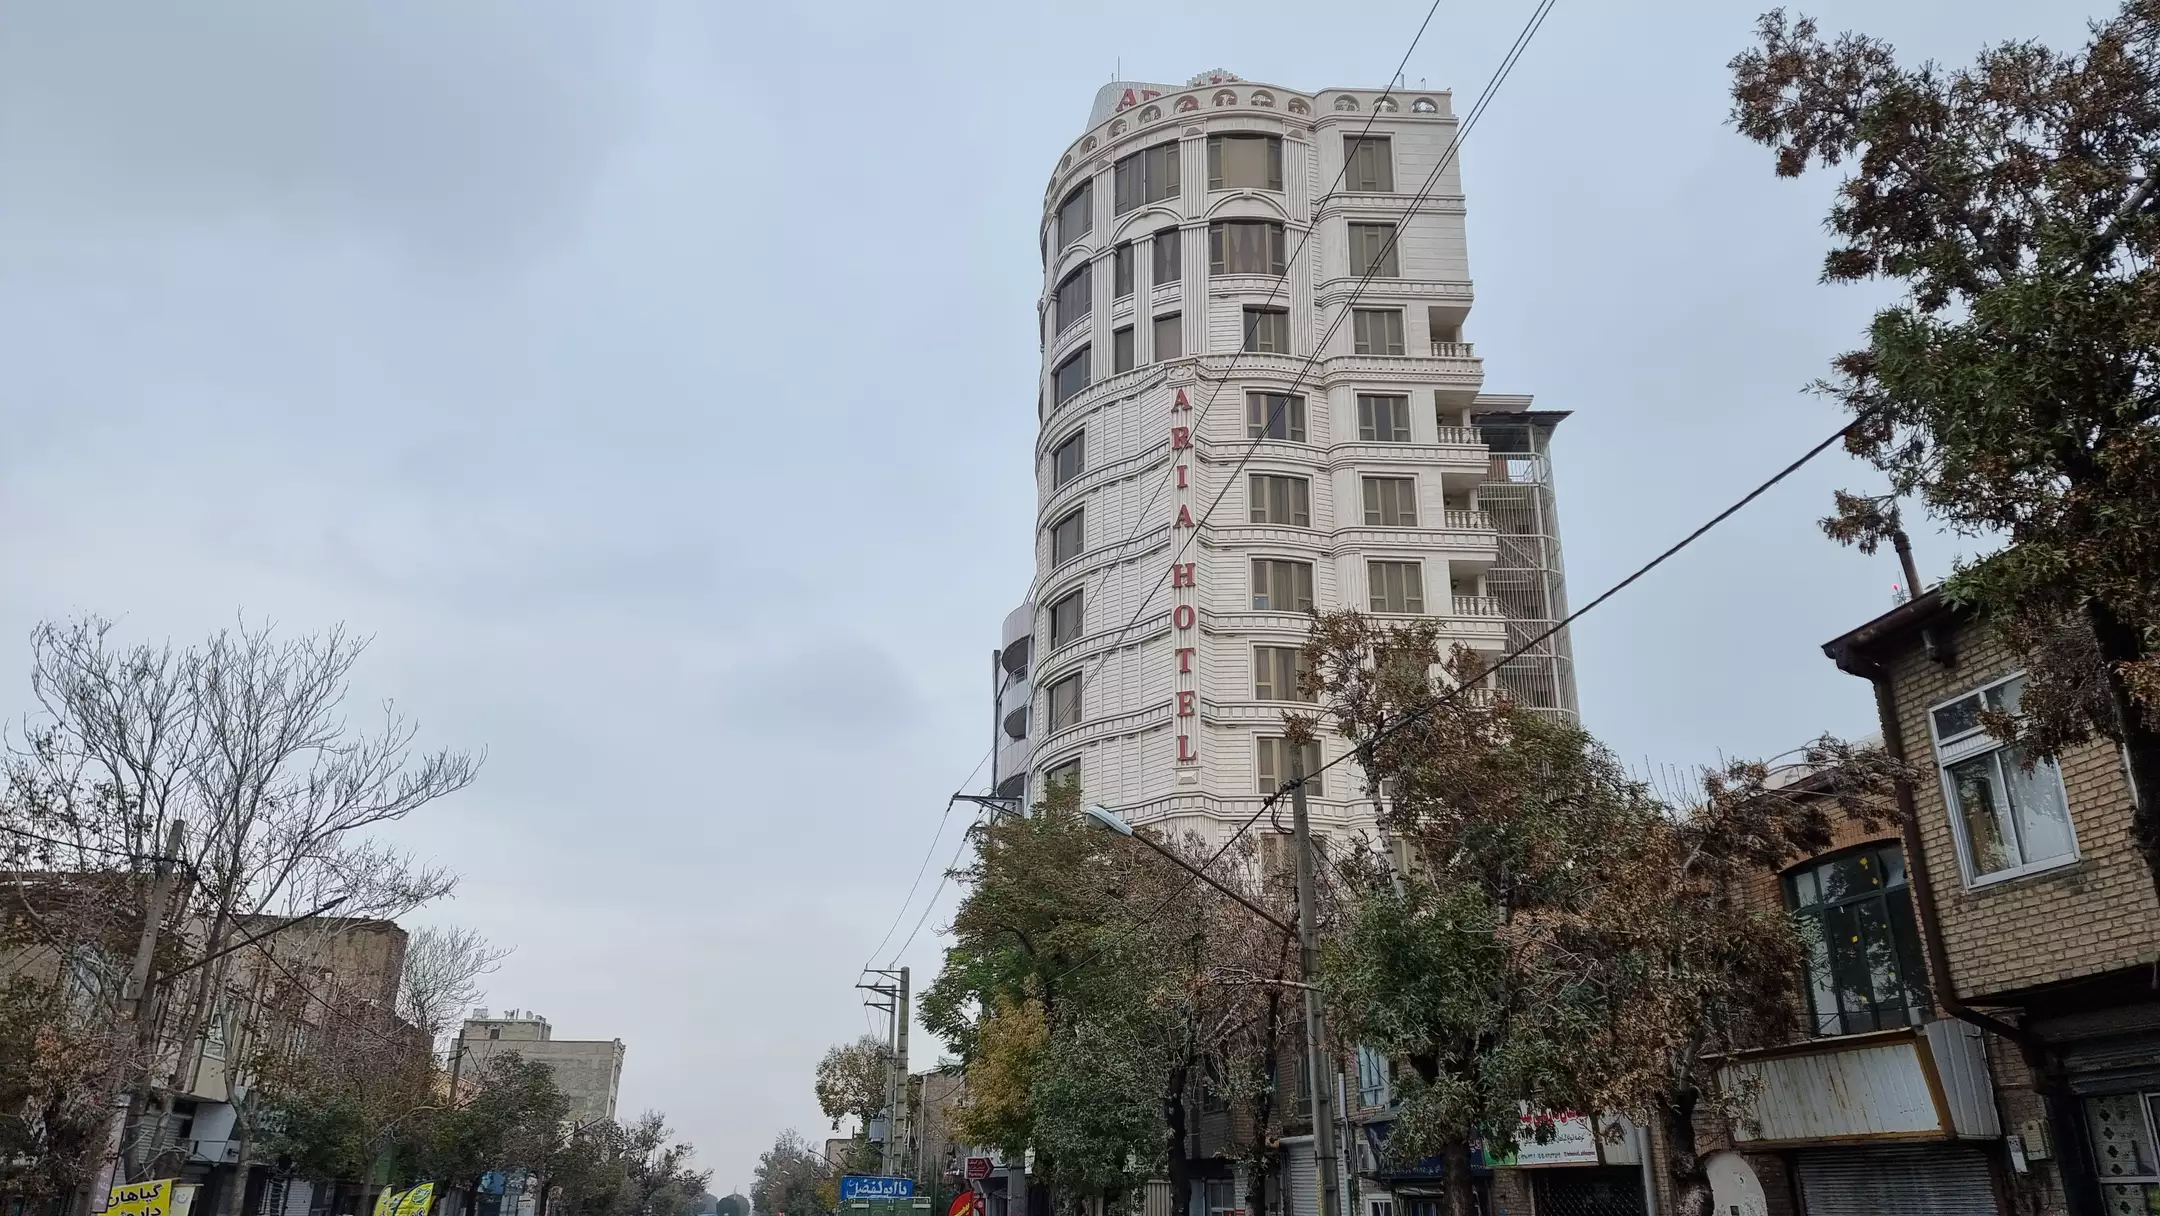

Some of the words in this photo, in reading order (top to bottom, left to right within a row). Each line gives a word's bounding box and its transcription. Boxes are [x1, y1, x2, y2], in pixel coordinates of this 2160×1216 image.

[1171, 388, 1196, 529] ARIA
[1172, 562, 1197, 762] HOTEL
[107, 1183, 163, 1208] گیاهان
